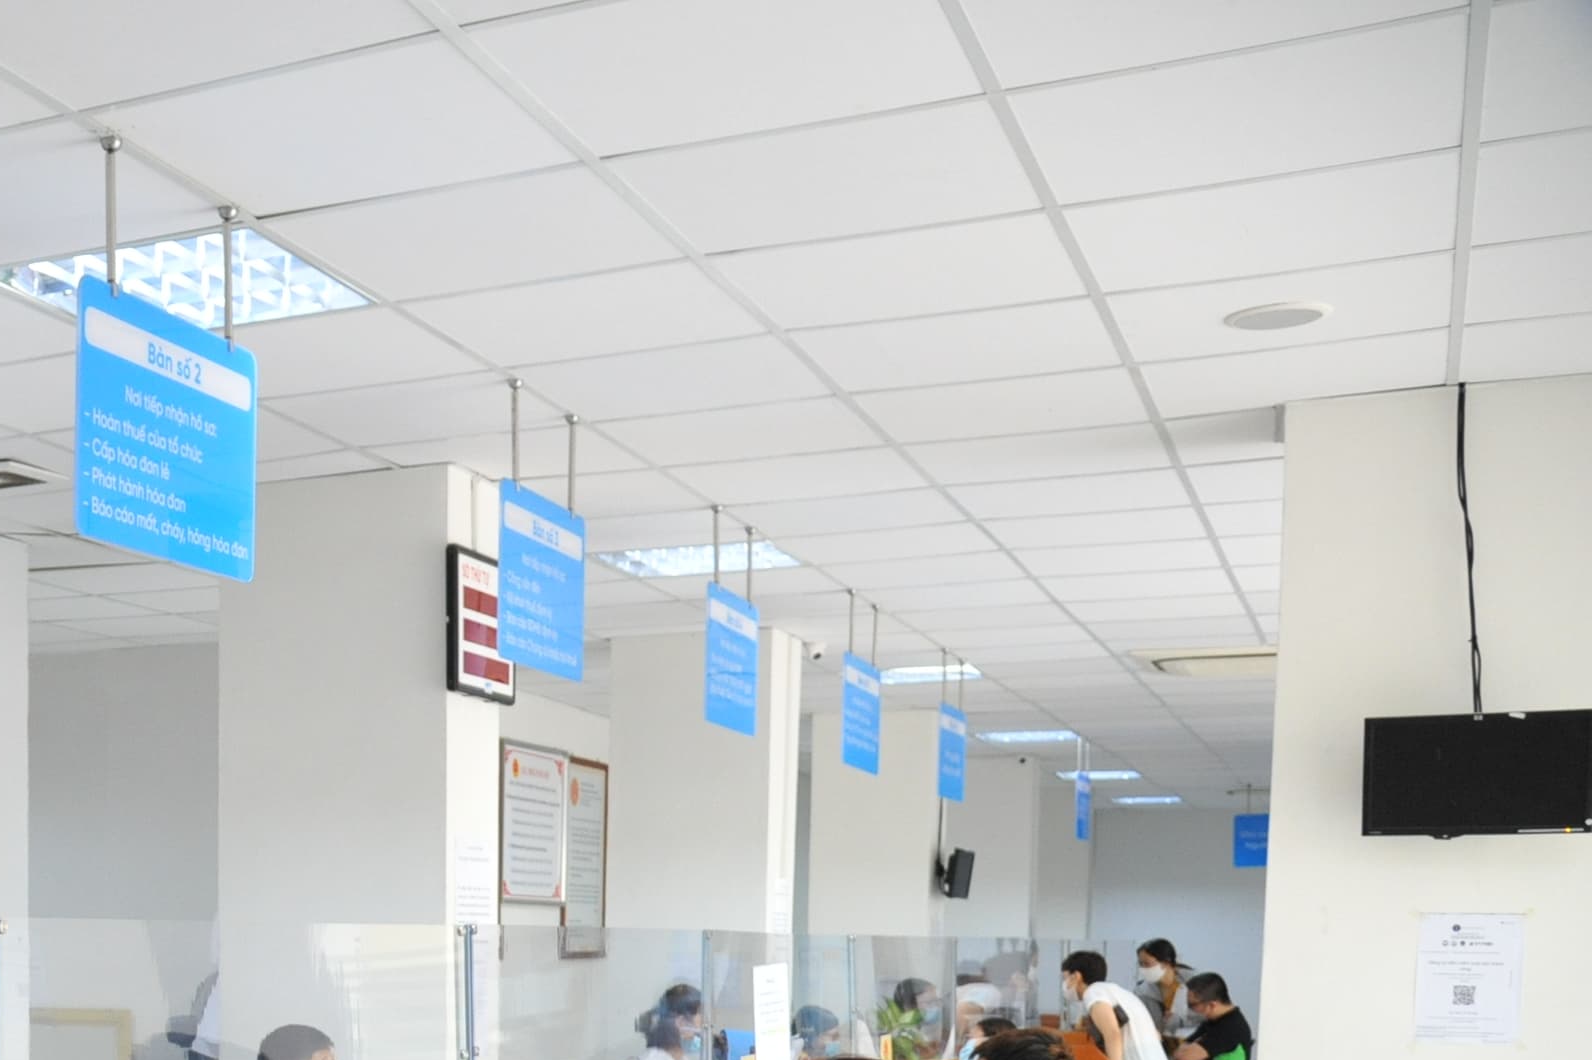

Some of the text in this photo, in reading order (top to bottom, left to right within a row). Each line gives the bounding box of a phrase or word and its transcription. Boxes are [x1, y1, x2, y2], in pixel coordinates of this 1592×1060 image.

[147, 342, 202, 384] Bàn số 2
